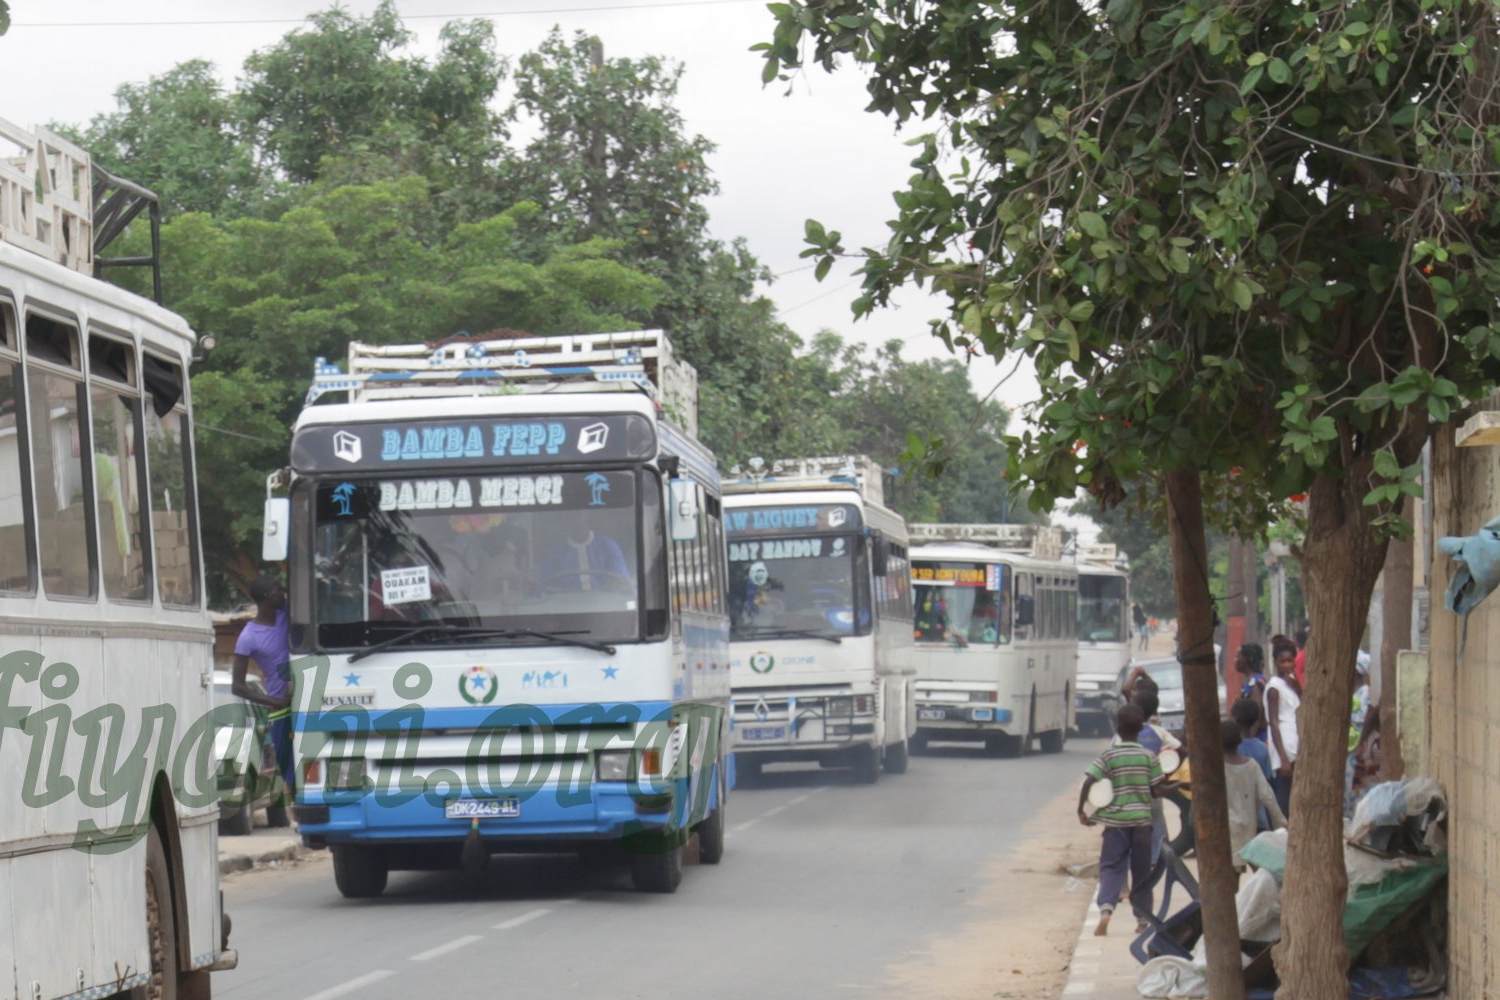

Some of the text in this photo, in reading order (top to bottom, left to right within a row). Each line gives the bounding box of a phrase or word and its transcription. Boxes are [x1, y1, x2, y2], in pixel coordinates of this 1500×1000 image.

[381, 422, 567, 461] BAMBA FEPP
[378, 474, 564, 512] BAMBA MERCI
[384, 576, 427, 589] OUAKAM
[321, 695, 374, 706] RENAULT
